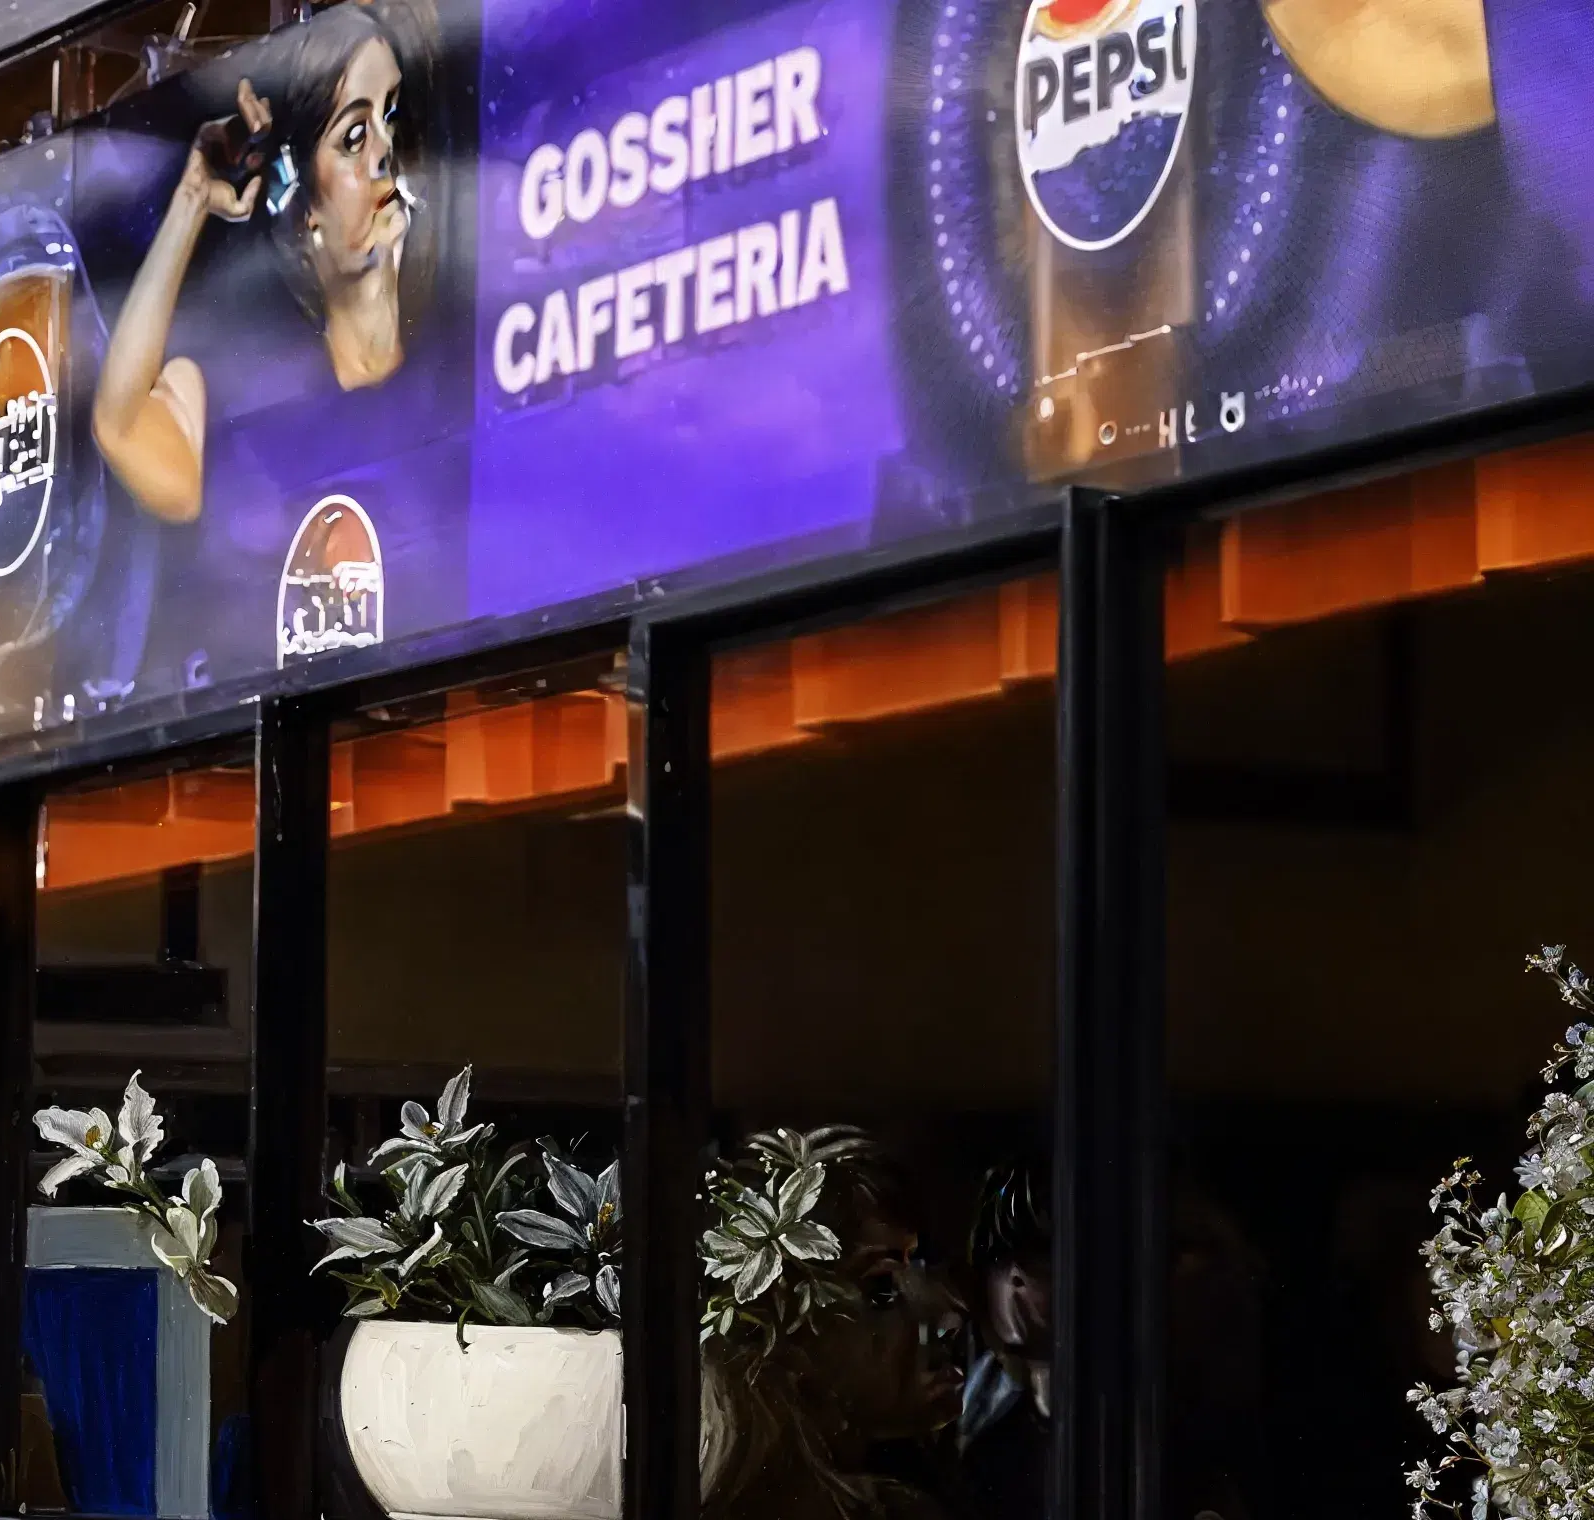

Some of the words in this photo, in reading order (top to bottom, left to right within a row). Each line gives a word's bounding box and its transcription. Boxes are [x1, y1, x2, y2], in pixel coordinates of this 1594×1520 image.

[518, 45, 823, 239] GOSSHER
[1023, 5, 1187, 140] PEPSI
[493, 197, 850, 394] CAFETERIA
